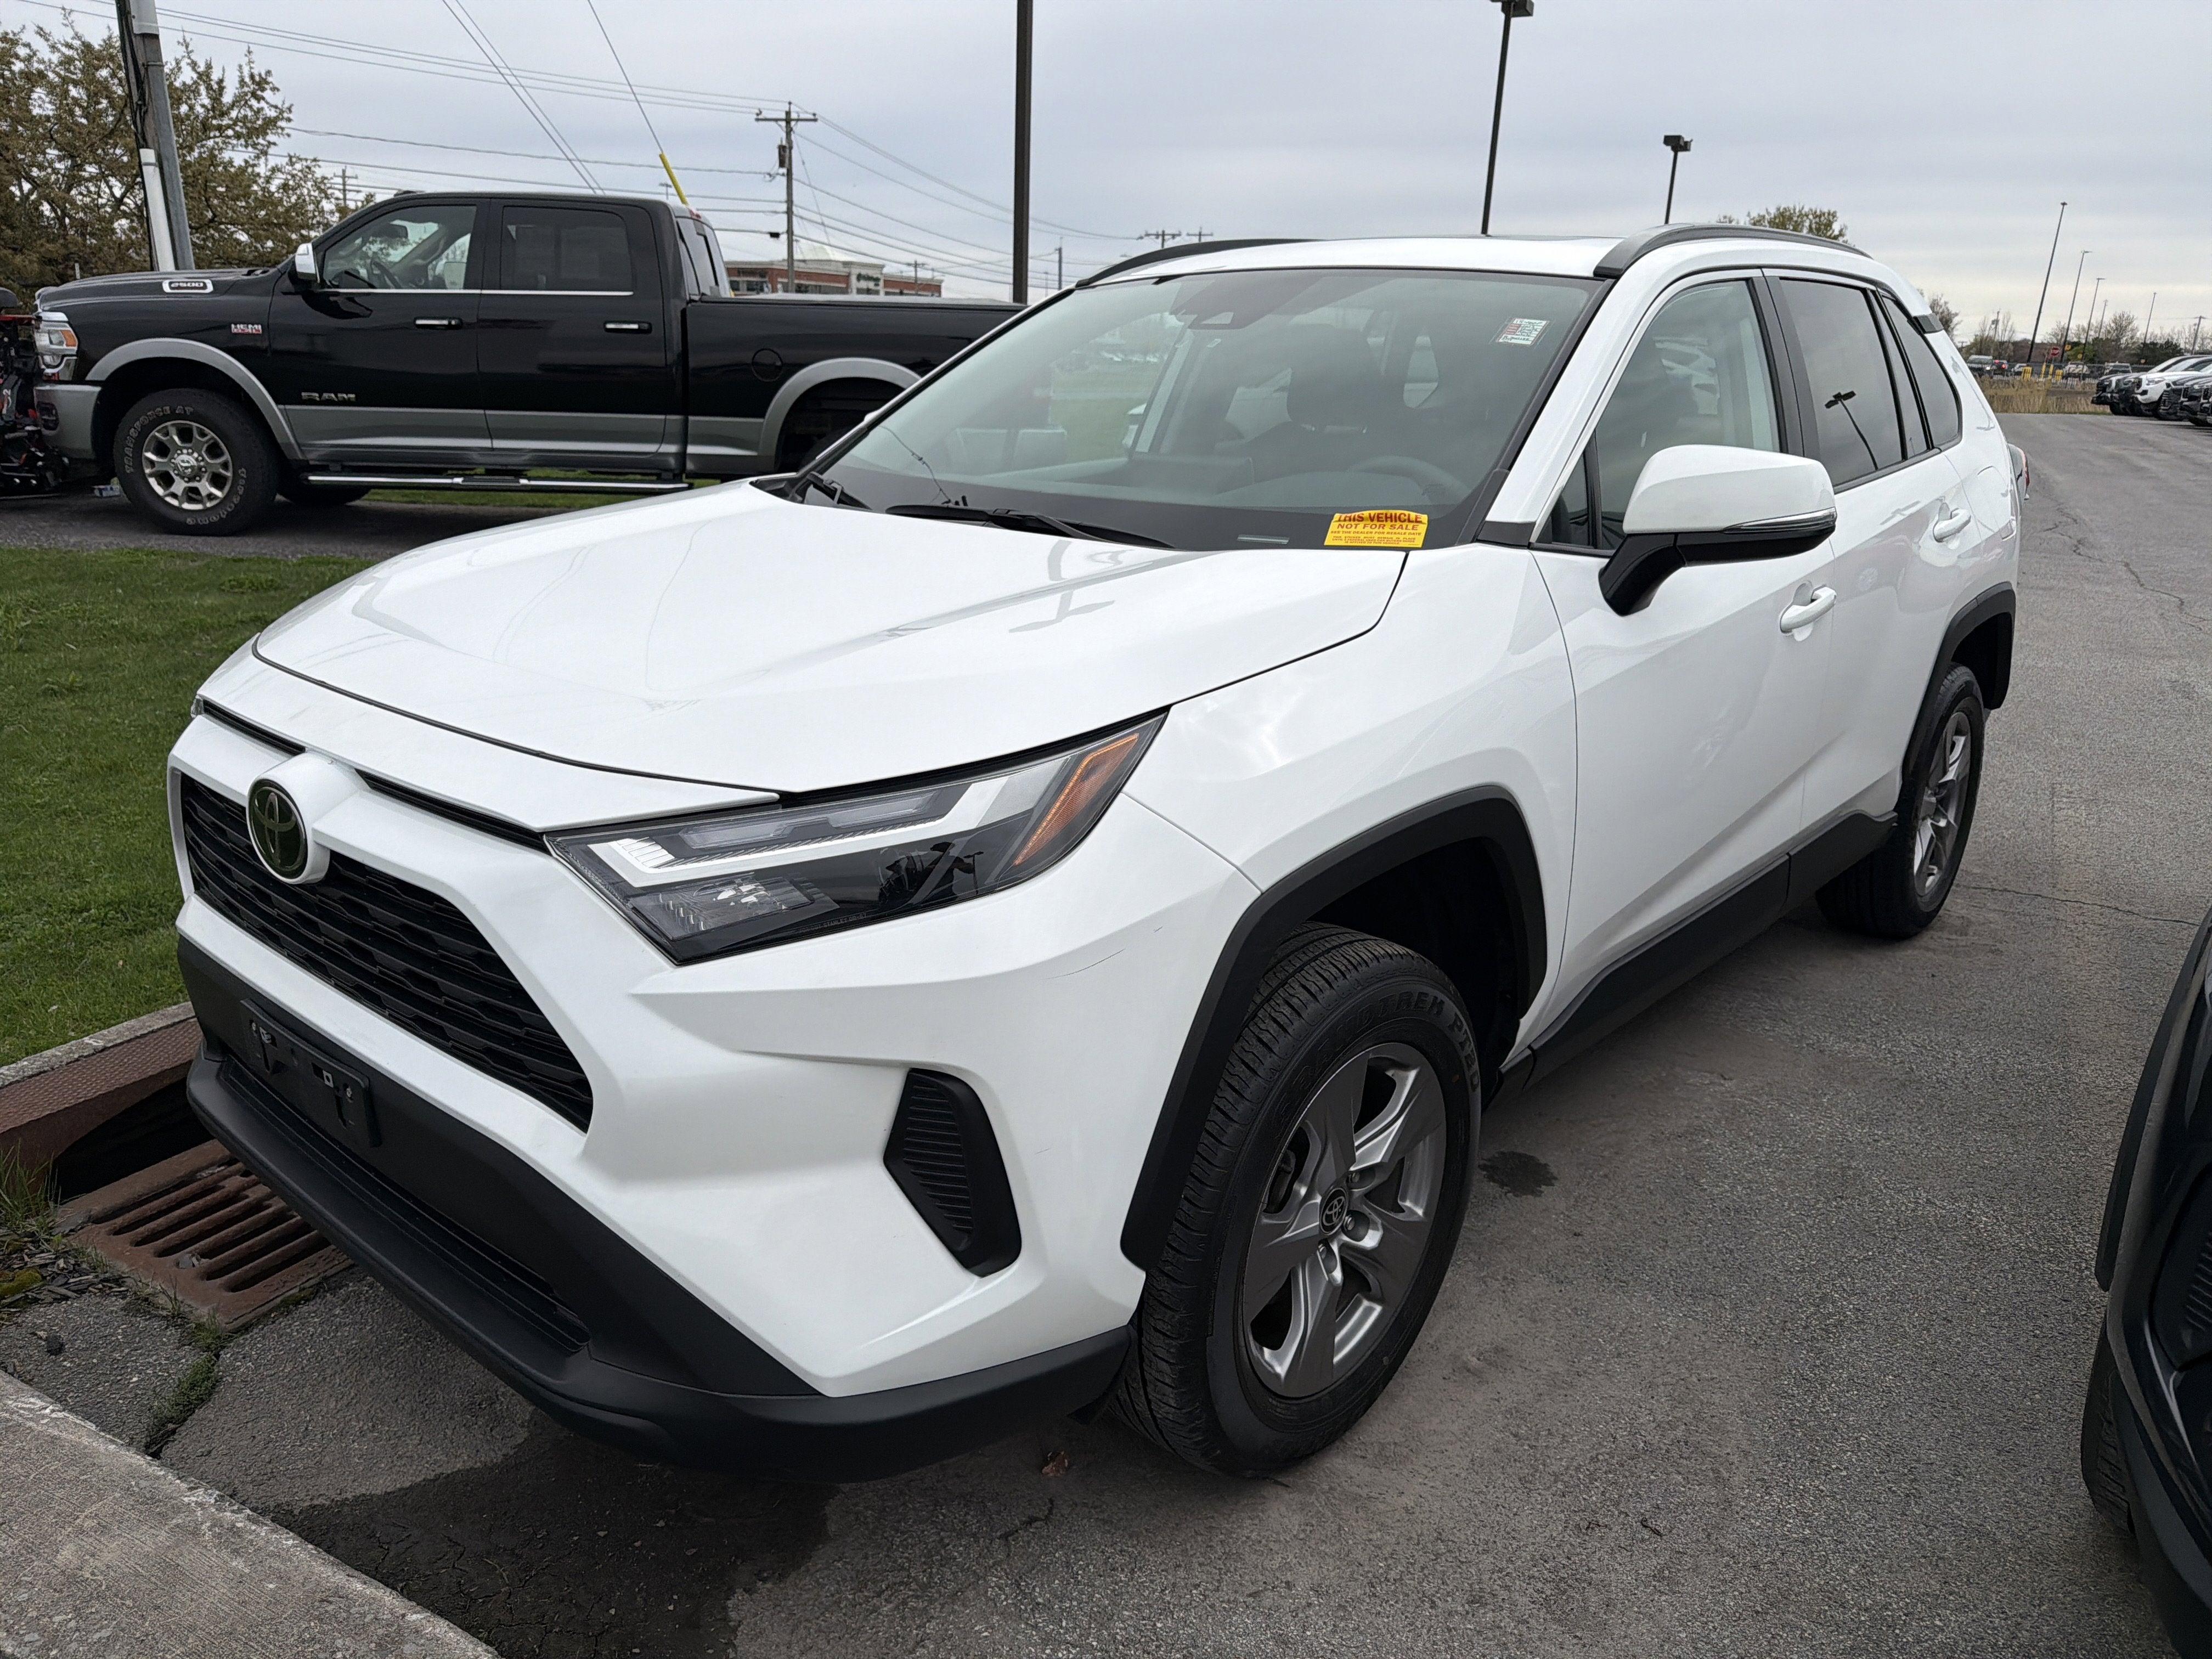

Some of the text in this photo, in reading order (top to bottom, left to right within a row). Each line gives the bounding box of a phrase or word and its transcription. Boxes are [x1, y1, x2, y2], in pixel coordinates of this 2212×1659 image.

[231, 324, 262, 332] HEMI
[301, 392, 356, 402] RAM
[1338, 512, 1423, 523] THIS VEHICLE
[823, 918, 847, 927] STANLEY
